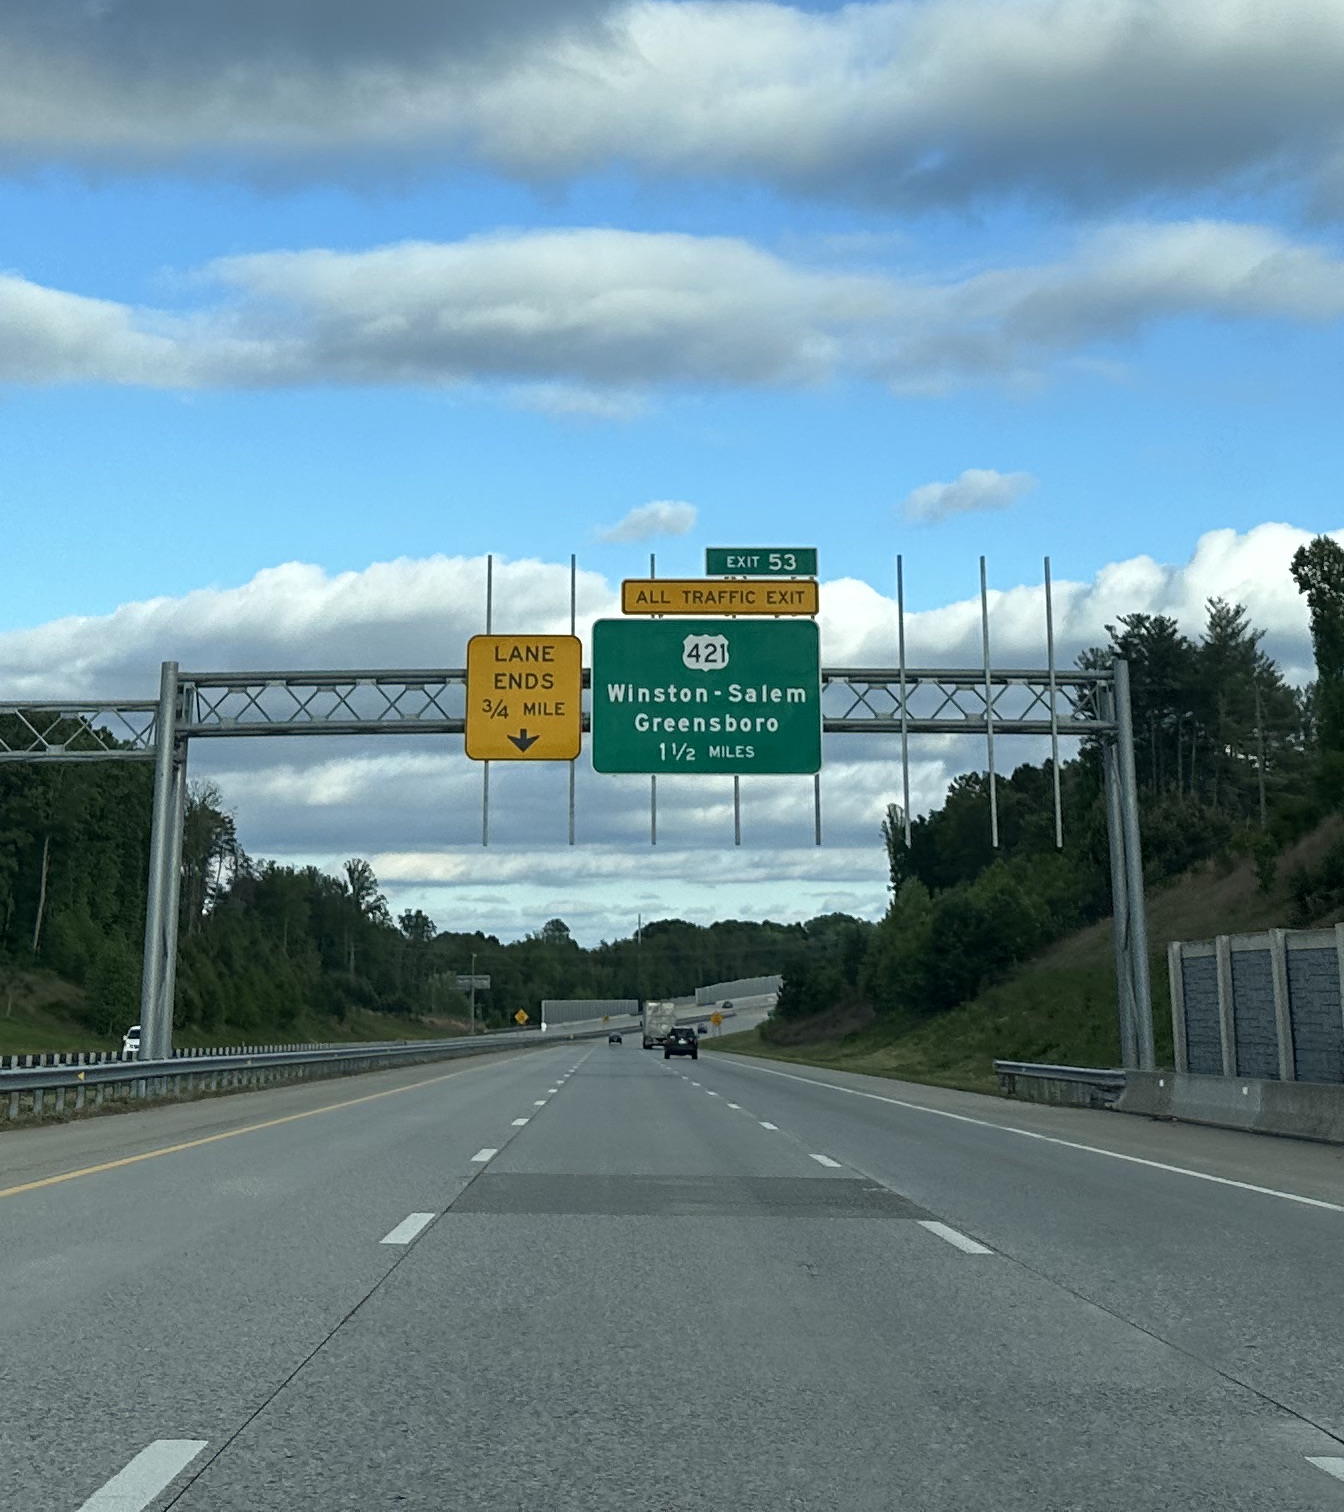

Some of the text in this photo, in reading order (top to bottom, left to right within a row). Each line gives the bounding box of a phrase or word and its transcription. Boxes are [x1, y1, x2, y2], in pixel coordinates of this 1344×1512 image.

[726, 554, 797, 570] EXIT 53
[635, 589, 805, 605] ALL TRAFFIC EXIT
[494, 645, 555, 663] LANE
[686, 642, 728, 664] 421
[494, 672, 554, 690] ENDS
[607, 683, 807, 704] Winston-Salem
[522, 701, 565, 717] MILE
[634, 713, 779, 733] Greensboro
[708, 745, 756, 759] MILES
